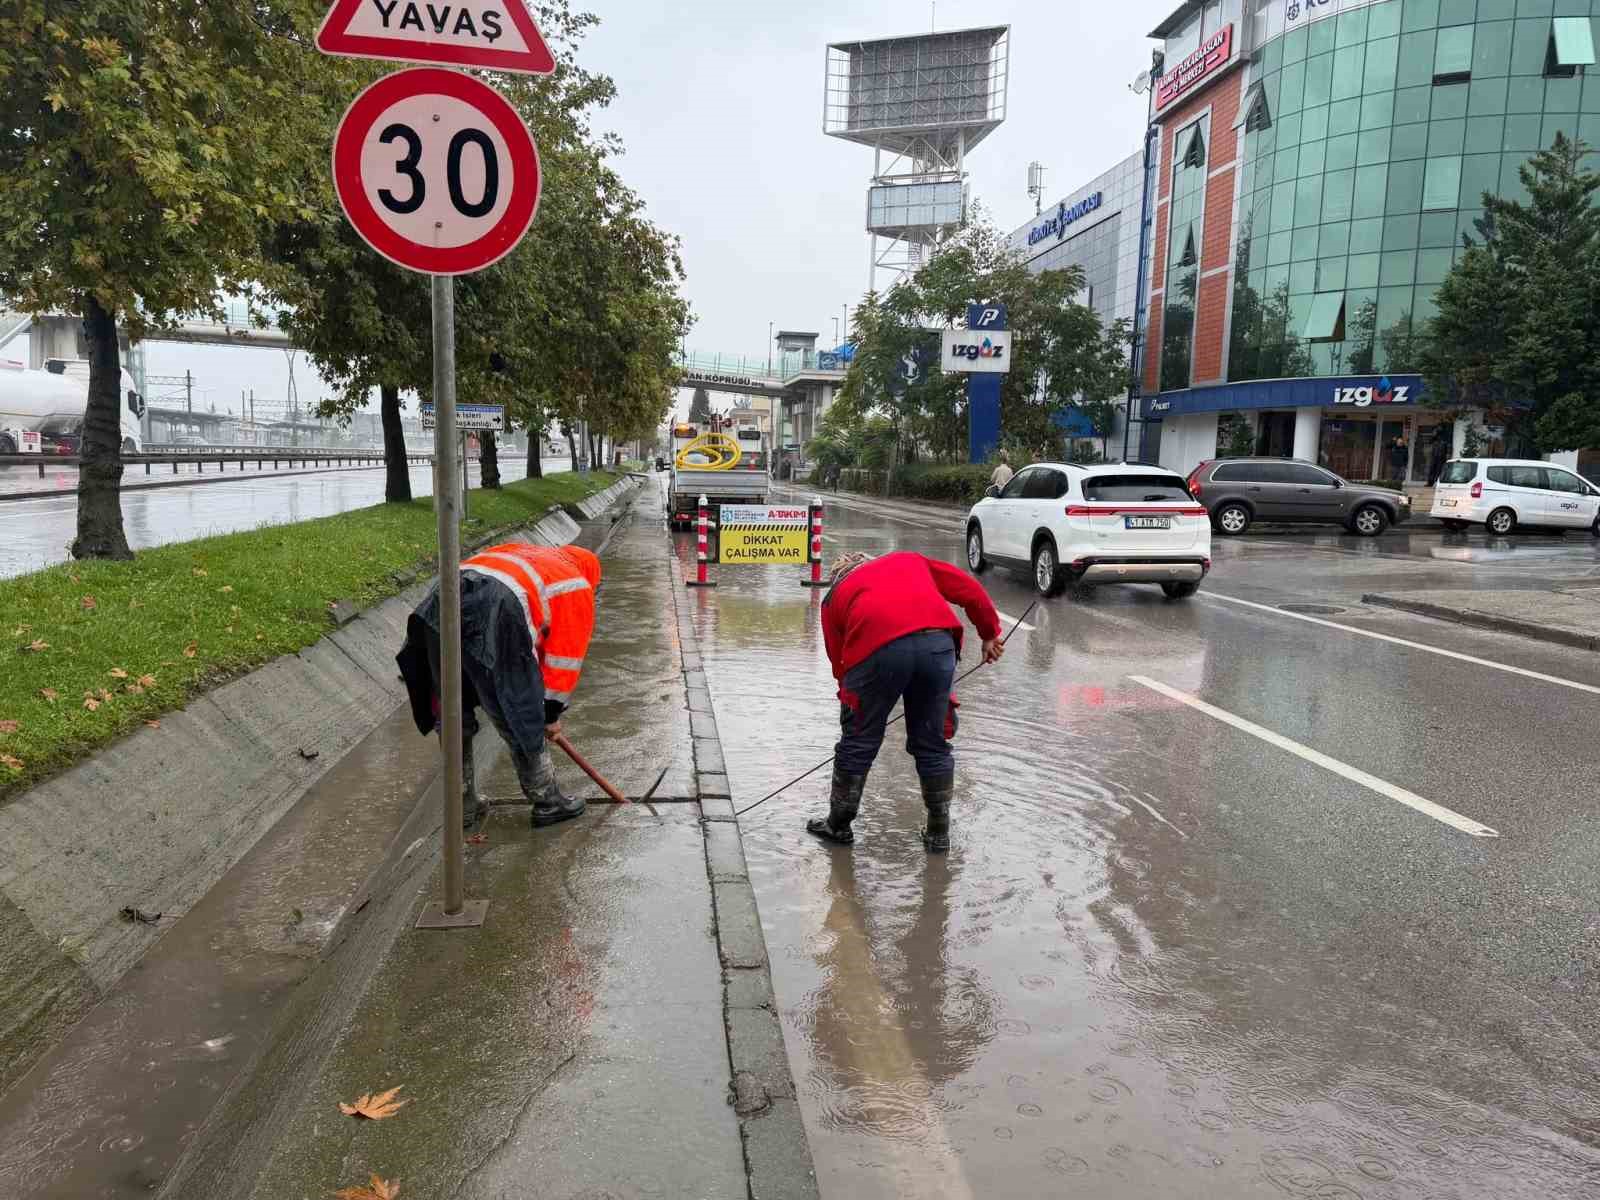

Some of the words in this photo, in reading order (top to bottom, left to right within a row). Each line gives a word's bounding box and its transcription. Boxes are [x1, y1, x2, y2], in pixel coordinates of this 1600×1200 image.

[374, 0, 503, 43] YAVAŞ
[377, 123, 499, 218] 30
[1063, 191, 1102, 225] BANKASI
[704, 374, 751, 386] KÖPRÜSÜ
[743, 532, 784, 545] DİKKAT
[726, 547, 776, 560] ÇALIŞMA
[777, 548, 800, 558] VAR
